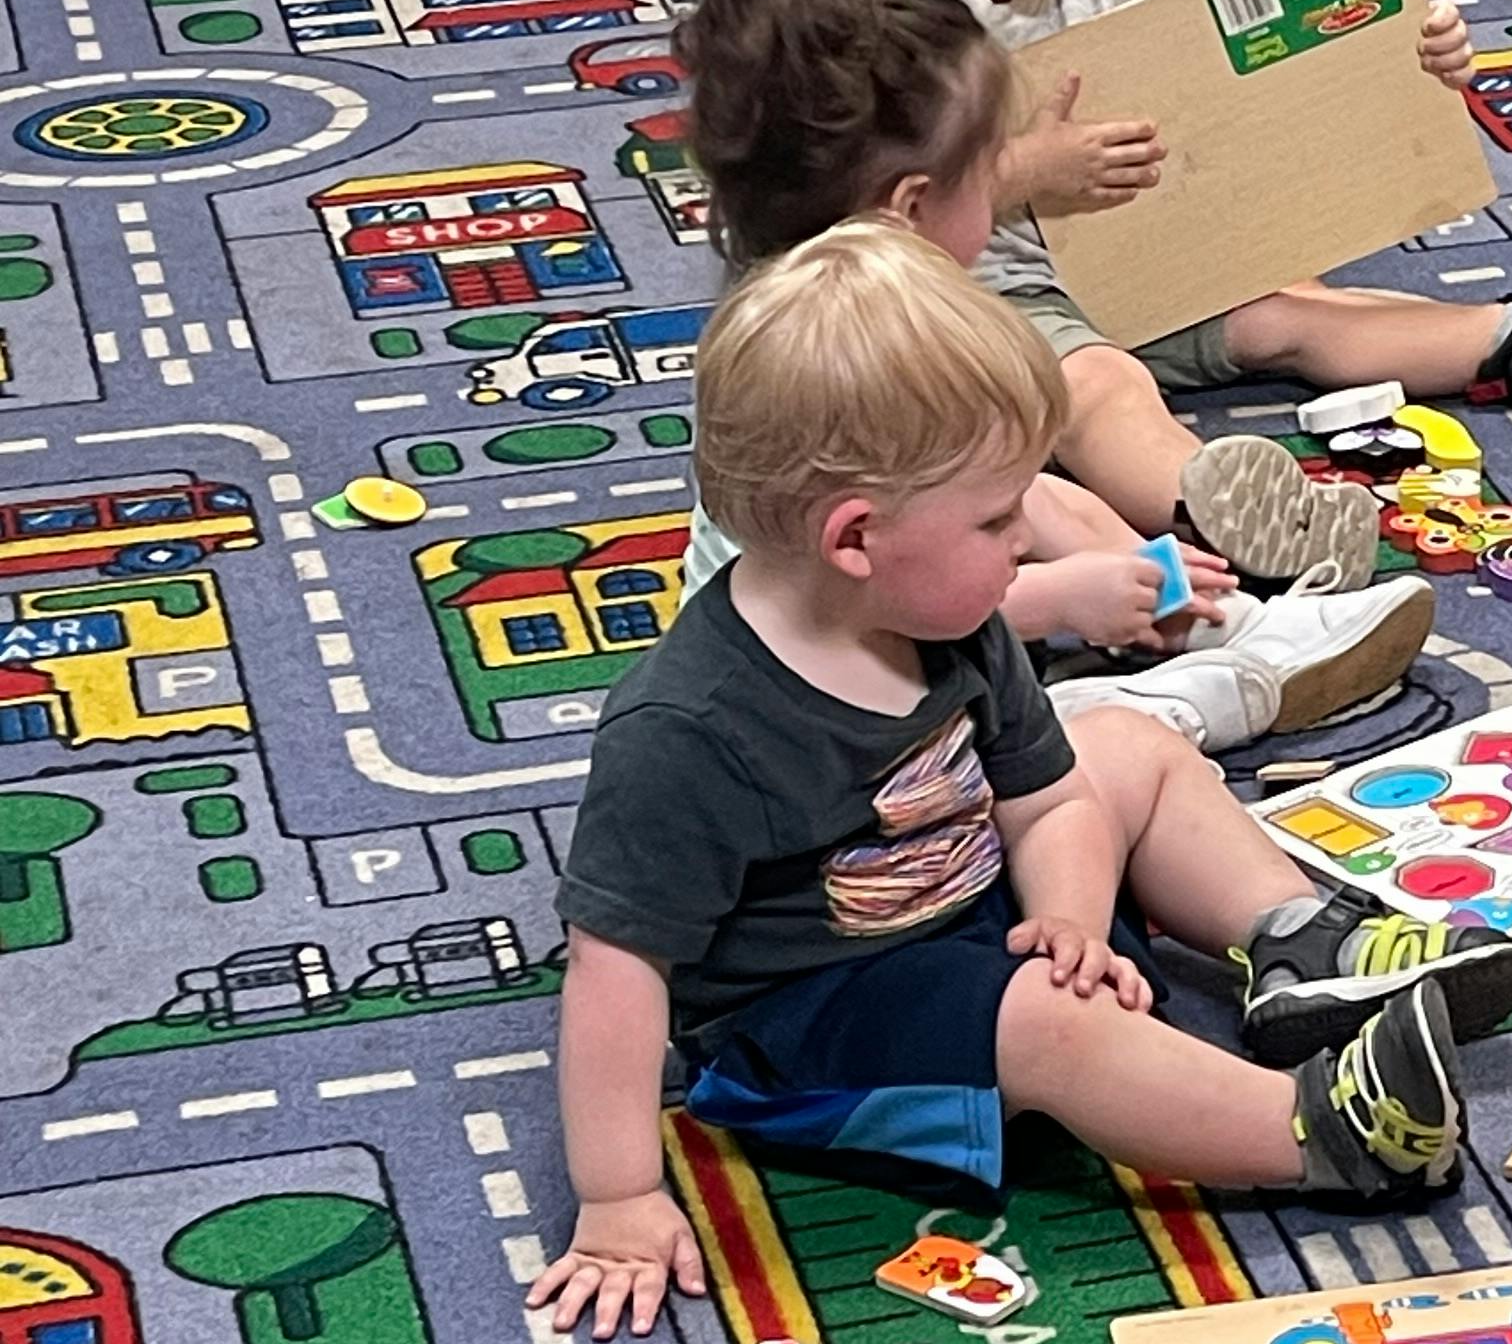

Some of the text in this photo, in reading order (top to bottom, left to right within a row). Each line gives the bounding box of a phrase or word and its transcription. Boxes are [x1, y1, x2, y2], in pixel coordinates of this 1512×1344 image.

[385, 213, 549, 246] SHOP
[0, 618, 81, 644] AR
[0, 634, 98, 663] ASH
[157, 665, 218, 698] P
[350, 849, 401, 884] P
